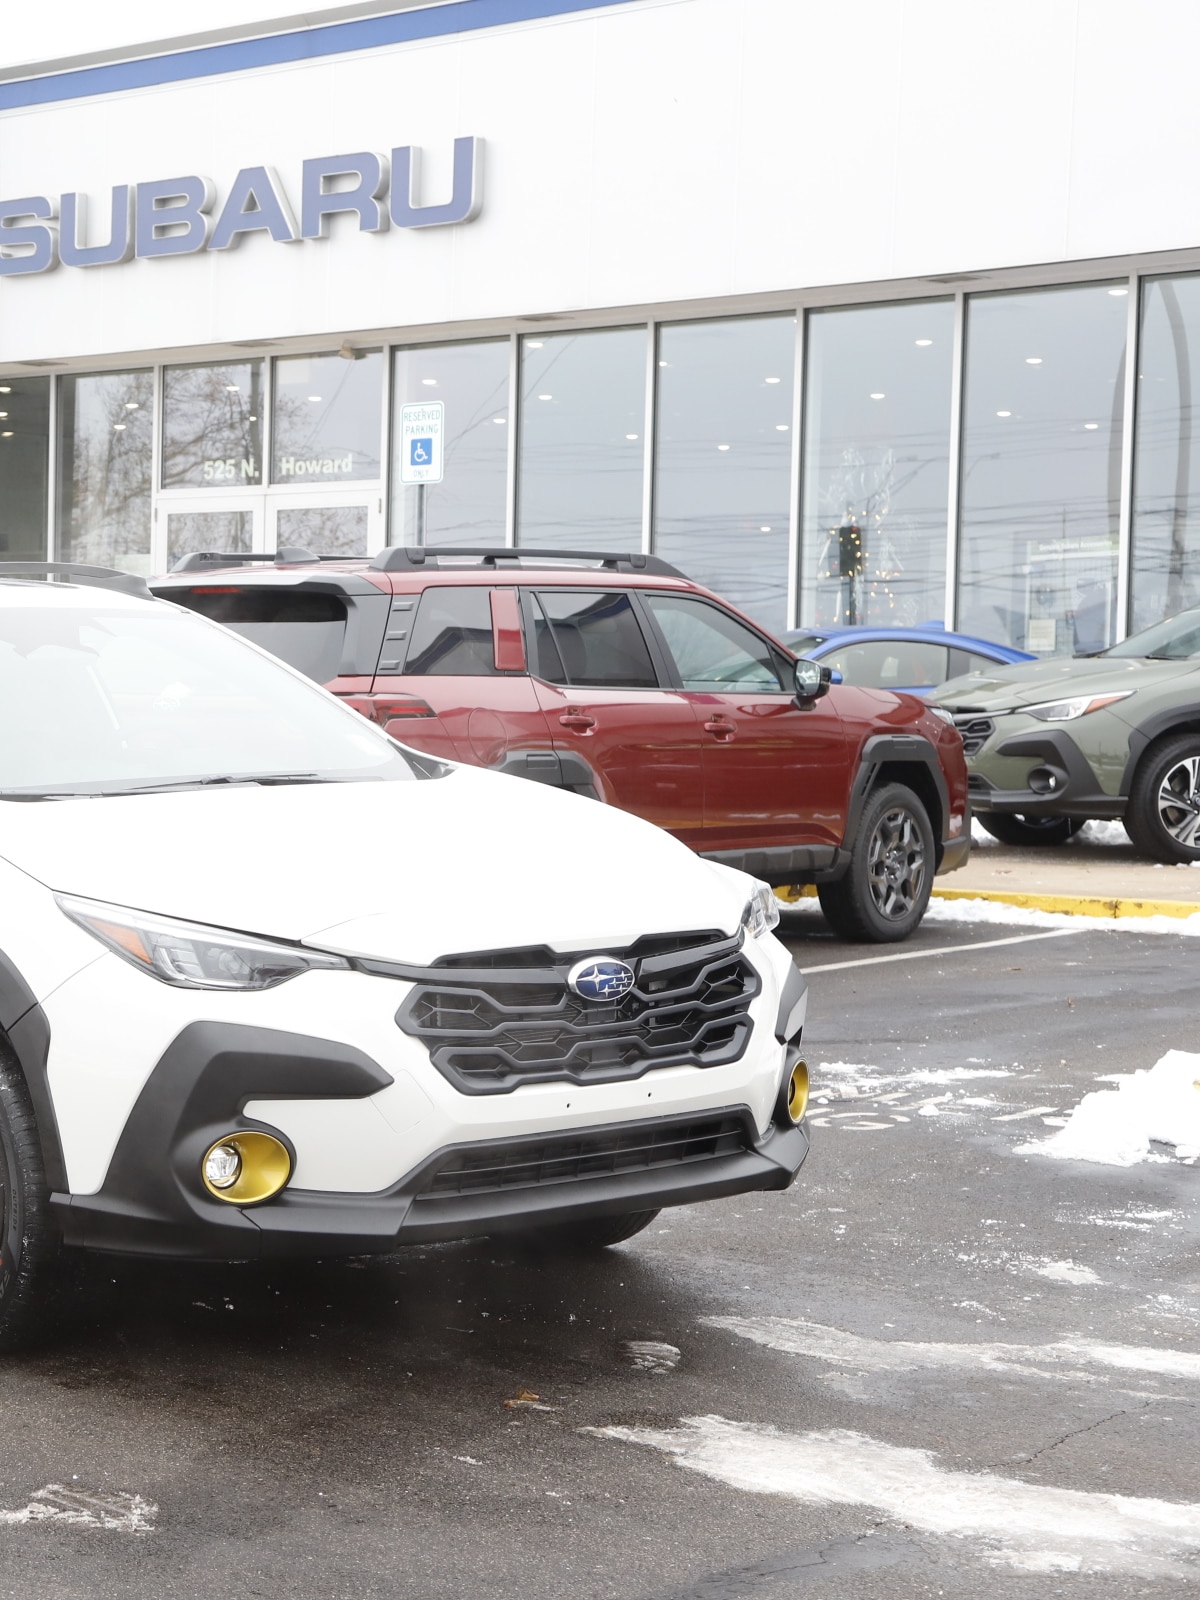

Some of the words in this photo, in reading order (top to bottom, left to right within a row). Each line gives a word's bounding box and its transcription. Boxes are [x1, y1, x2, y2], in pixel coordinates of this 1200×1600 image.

[403, 409, 441, 422] RESERVED
[405, 423, 439, 435] PARKING
[203, 458, 236, 480] 525
[240, 458, 260, 478] N.
[280, 453, 353, 476] Howard
